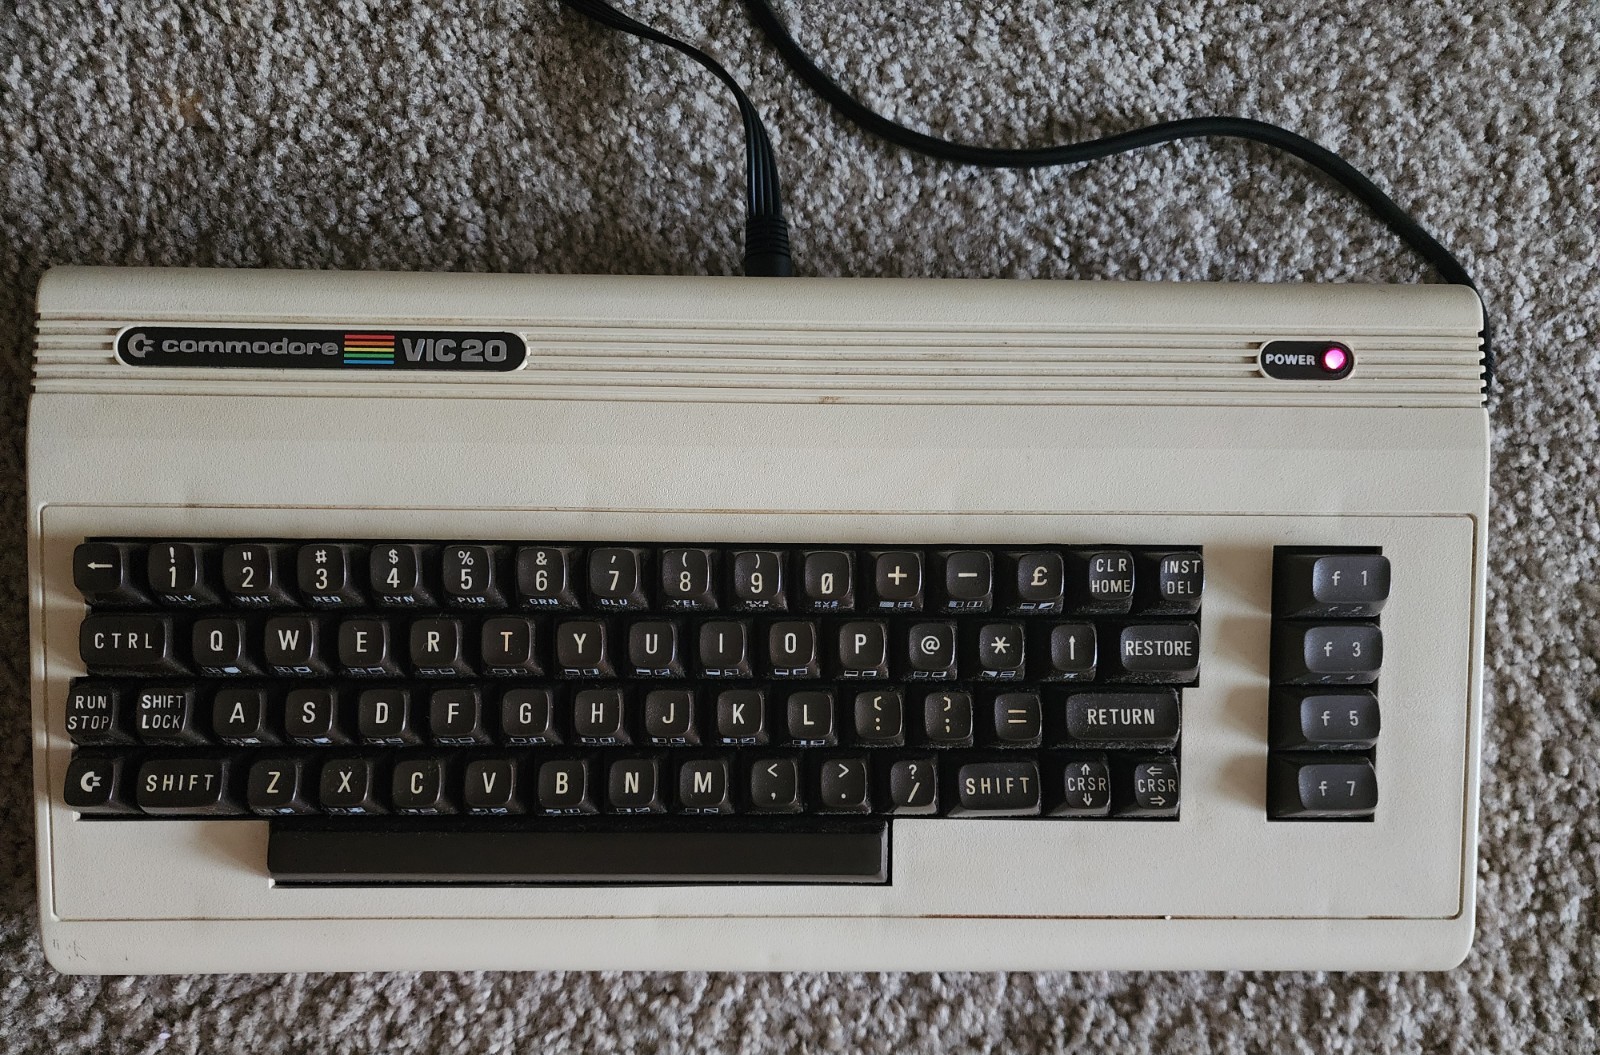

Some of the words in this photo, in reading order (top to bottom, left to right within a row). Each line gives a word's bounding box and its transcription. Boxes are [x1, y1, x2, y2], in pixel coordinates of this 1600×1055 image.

[161, 337, 339, 356] commodore
[1265, 353, 1316, 366] POWER
[314, 549, 328, 564] #
[388, 548, 399, 565] $
[457, 550, 474, 566] %
[535, 551, 548, 566] &
[1095, 558, 1127, 573] CLR
[1164, 560, 1200, 574] INST
[168, 565, 177, 588] 1
[241, 566, 254, 588] 2
[315, 568, 328, 590] 3
[386, 567, 401, 589] 4
[460, 568, 473, 590] 5
[535, 569, 548, 592] 6
[608, 570, 620, 591] 7
[679, 570, 692, 592] 8
[750, 572, 763, 594] 9
[1030, 566, 1048, 586] £
[1091, 579, 1131, 594] HOME
[1165, 580, 1194, 595] DEL
[237, 595, 270, 603] WHT
[94, 632, 153, 649] CTRL
[210, 630, 224, 652] Q
[277, 629, 300, 651] W
[356, 631, 368, 653] E
[427, 631, 440, 653] R
[500, 631, 514, 652] T
[573, 633, 587, 654] Y
[645, 633, 658, 655] U
[784, 632, 797, 654] O
[854, 633, 867, 655] P
[920, 635, 941, 655] @
[1125, 640, 1192, 656] RESTORE
[1352, 641, 1361, 658] 3
[75, 695, 107, 710] RUN
[141, 694, 184, 710] SHIFT
[302, 701, 316, 724] S
[67, 715, 109, 730] STOP
[141, 714, 181, 729] LOCK
[229, 702, 245, 724] A
[375, 702, 389, 724] D
[447, 702, 460, 724] F
[519, 702, 532, 724] G
[590, 702, 604, 724] H
[662, 702, 675, 724] J
[732, 703, 745, 725] K
[803, 704, 815, 726] L
[1087, 708, 1155, 725] RETURN
[1349, 710, 1359, 727] 5
[337, 771, 353, 793] X
[908, 763, 918, 780] ?
[145, 774, 214, 793] SHIFT
[266, 771, 281, 794] Z
[410, 771, 424, 794] C
[482, 771, 497, 794] V
[555, 771, 569, 795] B
[624, 771, 639, 794] N
[693, 771, 712, 794] M
[965, 777, 1030, 795] SHIFT
[1067, 776, 1106, 792] CRSR
[1137, 778, 1176, 793] CRSR
[1346, 780, 1356, 797] 7
